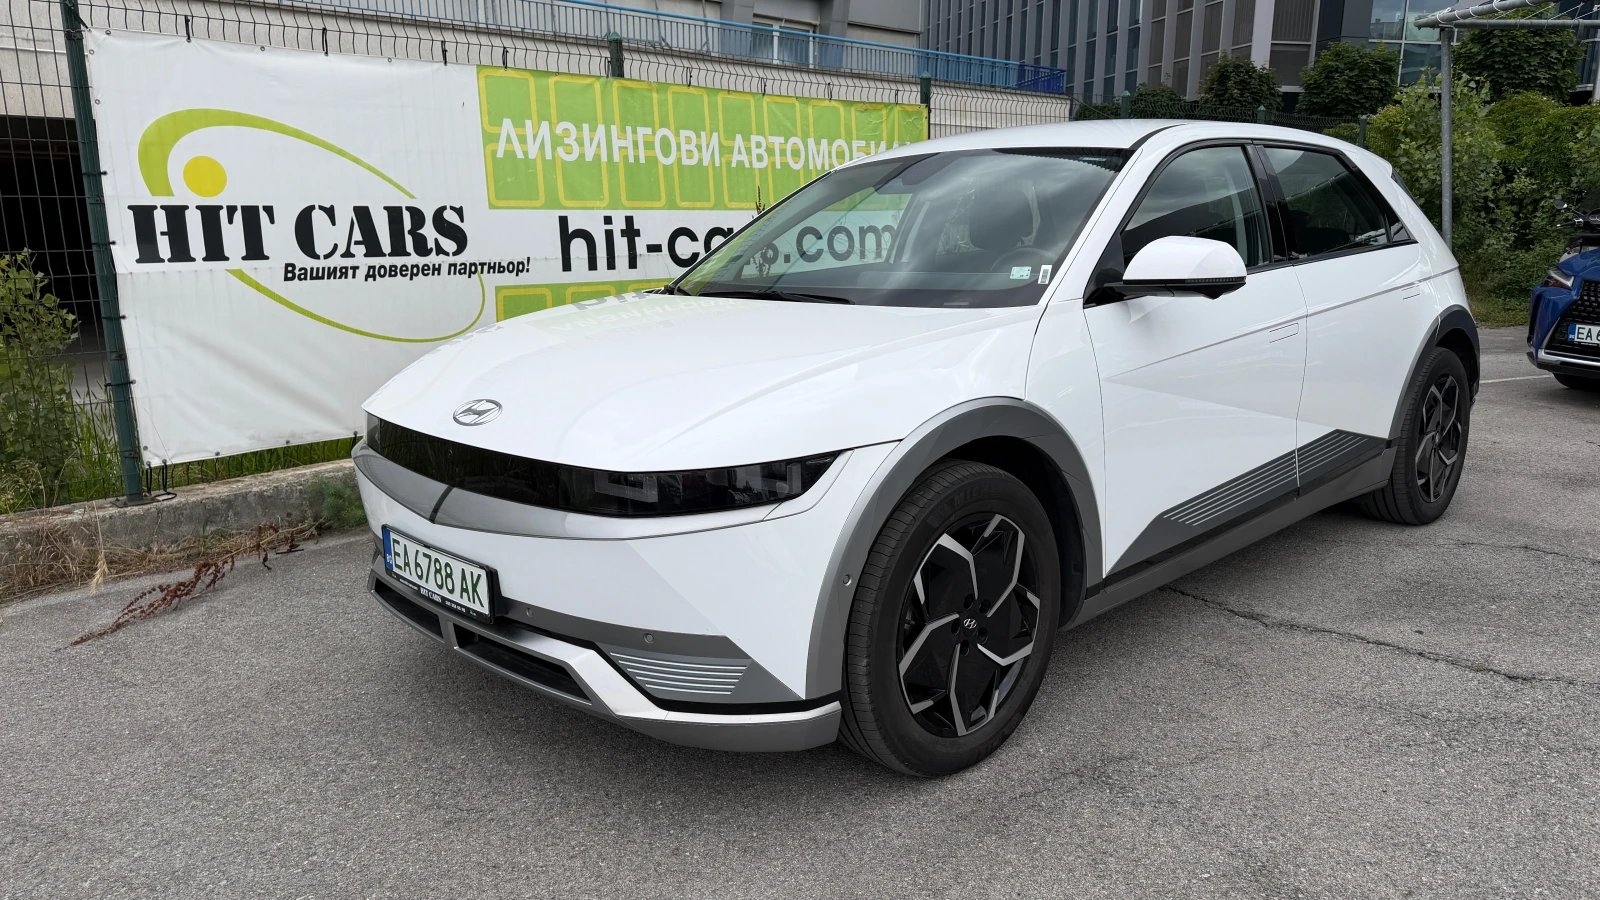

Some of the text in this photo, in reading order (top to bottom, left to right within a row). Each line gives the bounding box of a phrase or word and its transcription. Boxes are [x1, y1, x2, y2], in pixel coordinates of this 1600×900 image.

[496, 118, 911, 171] ЛИЗИНГОВИ АВТОМОБ
[128, 204, 468, 263] HIT CARS
[283, 256, 531, 282] Вашият доверен партньор!
[1577, 327, 1592, 341] EA
[392, 537, 485, 608] EA 6788 AK
